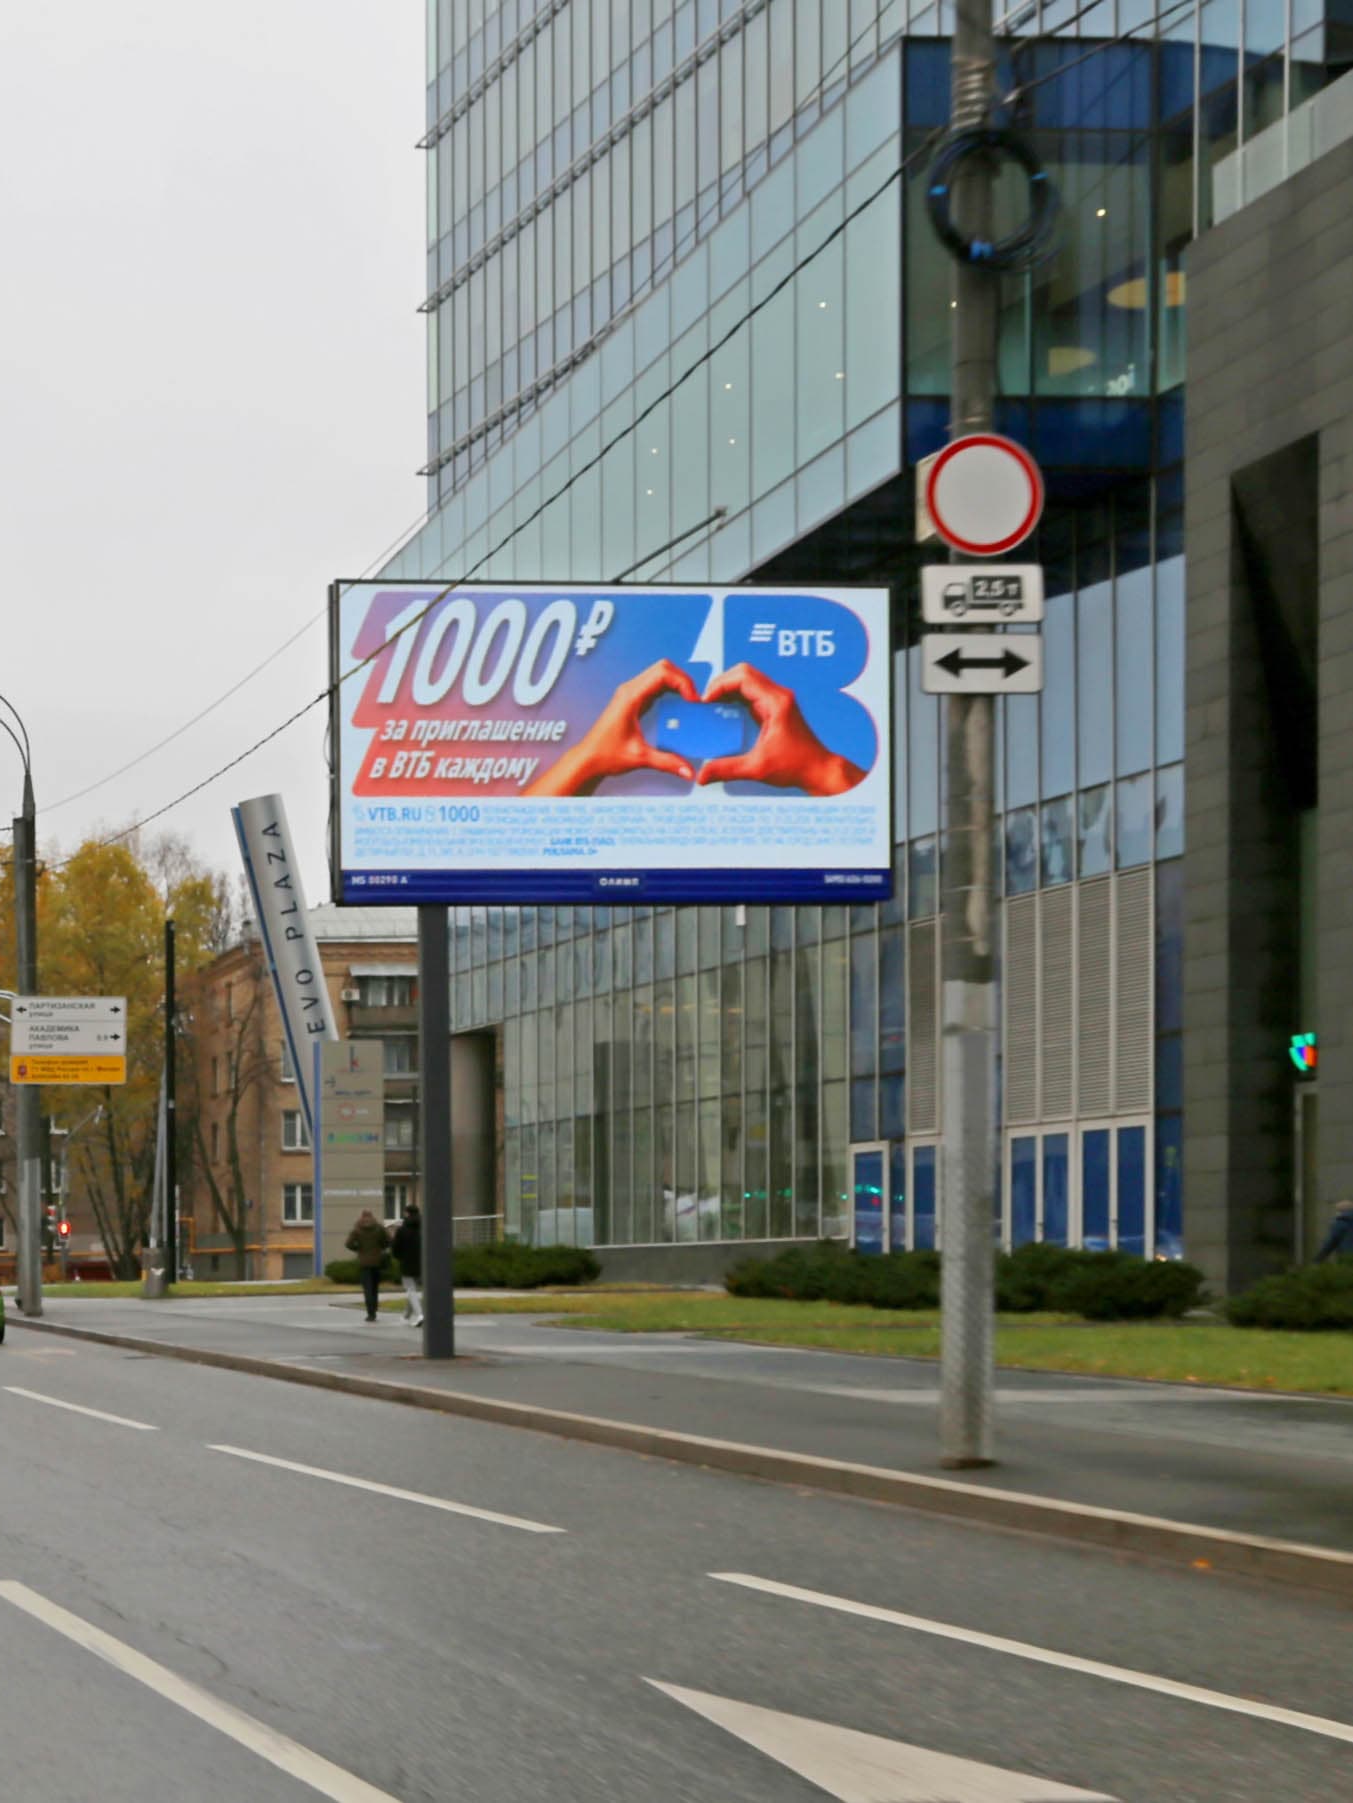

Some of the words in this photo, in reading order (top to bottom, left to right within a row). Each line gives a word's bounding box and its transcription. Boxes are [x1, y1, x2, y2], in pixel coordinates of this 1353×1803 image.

[778, 630, 836, 657] ВТБ
[380, 720, 408, 741] за
[411, 719, 567, 747] приглашение
[369, 758, 388, 779] в
[389, 751, 435, 779] ВТБ
[434, 757, 539, 785] каждому
[368, 807, 422, 822] VTB.RU
[439, 806, 480, 822] 1000
[262, 822, 304, 941] PLAZA
[29, 1002, 95, 1010] ПАРТИЗАНСКАЯ
[295, 969, 326, 1034] EVO
